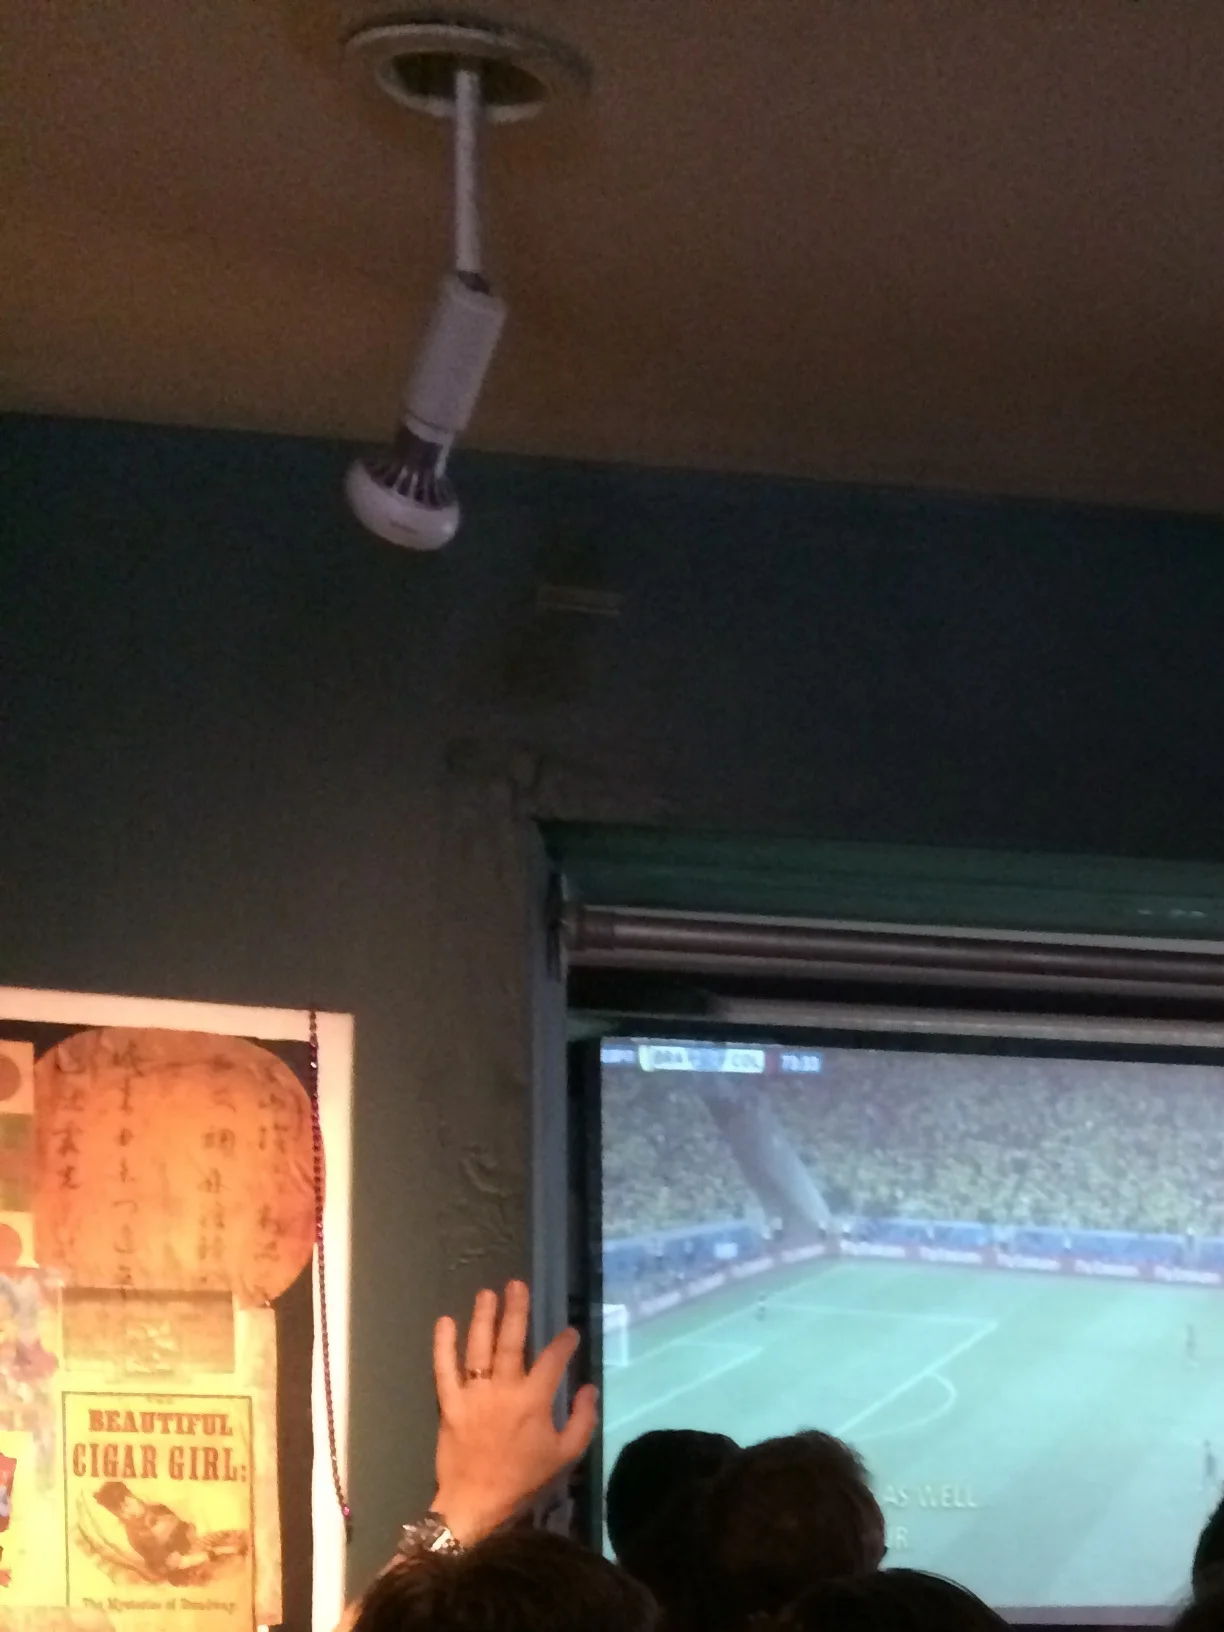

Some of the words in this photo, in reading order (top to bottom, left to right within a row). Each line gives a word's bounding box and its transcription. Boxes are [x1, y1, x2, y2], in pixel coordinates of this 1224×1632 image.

[88, 1409, 233, 1436] BEAUTIFUL
[73, 1442, 158, 1479] CIGAR
[168, 1445, 247, 1482] GIRL:
[917, 1484, 979, 1509] WELL
